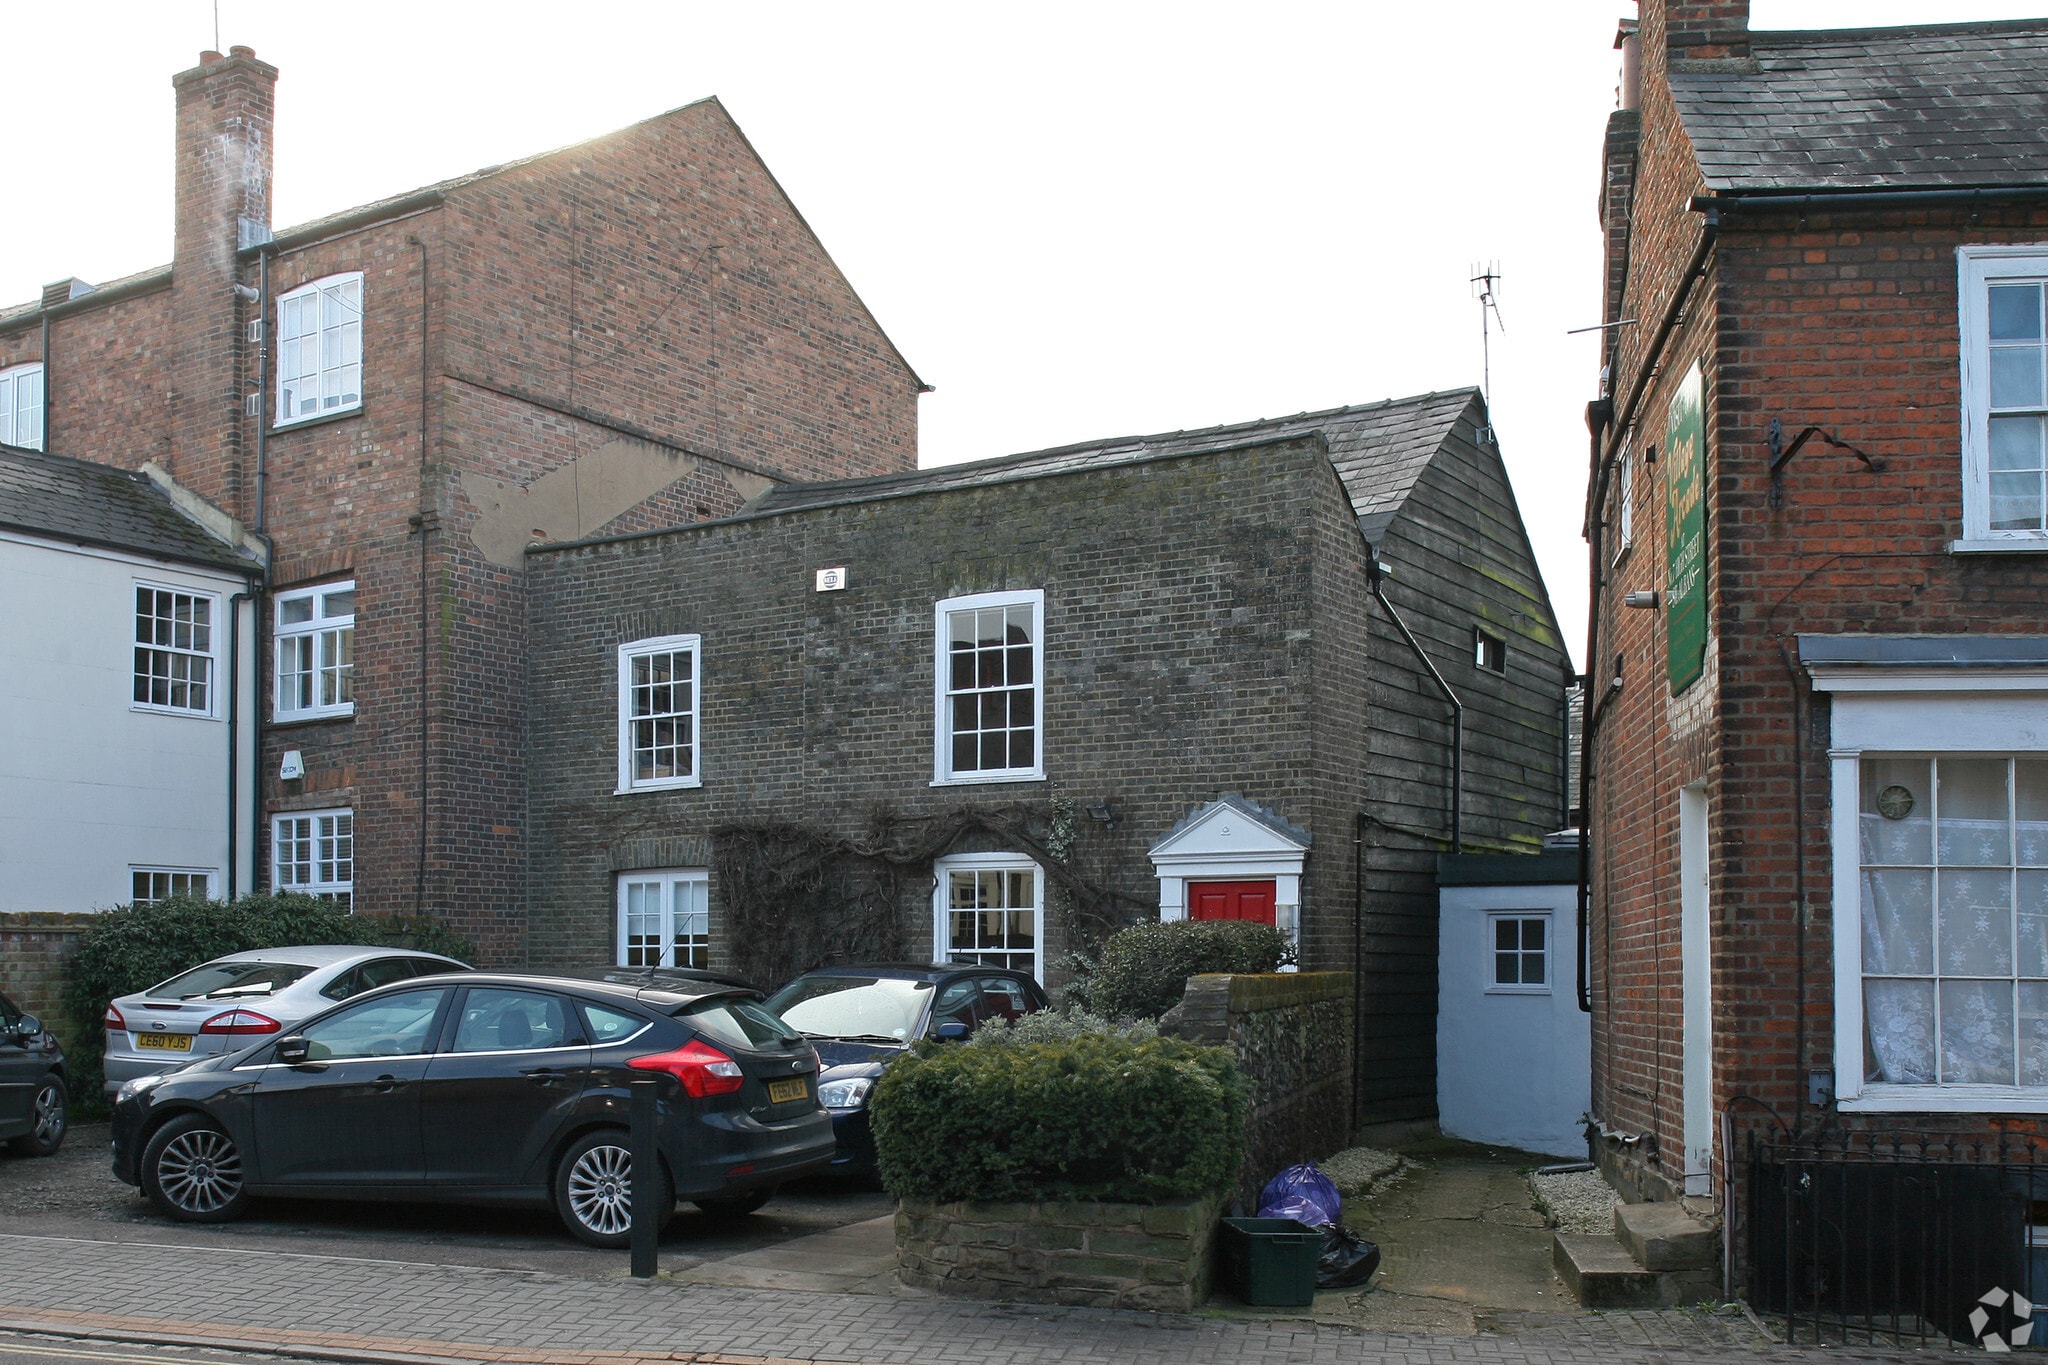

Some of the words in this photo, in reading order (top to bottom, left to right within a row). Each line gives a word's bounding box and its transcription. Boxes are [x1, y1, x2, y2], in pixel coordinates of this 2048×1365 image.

[1670, 464, 1700, 549] Arcade
[140, 1034, 165, 1047] CE60
[168, 1035, 187, 1048] YJS
